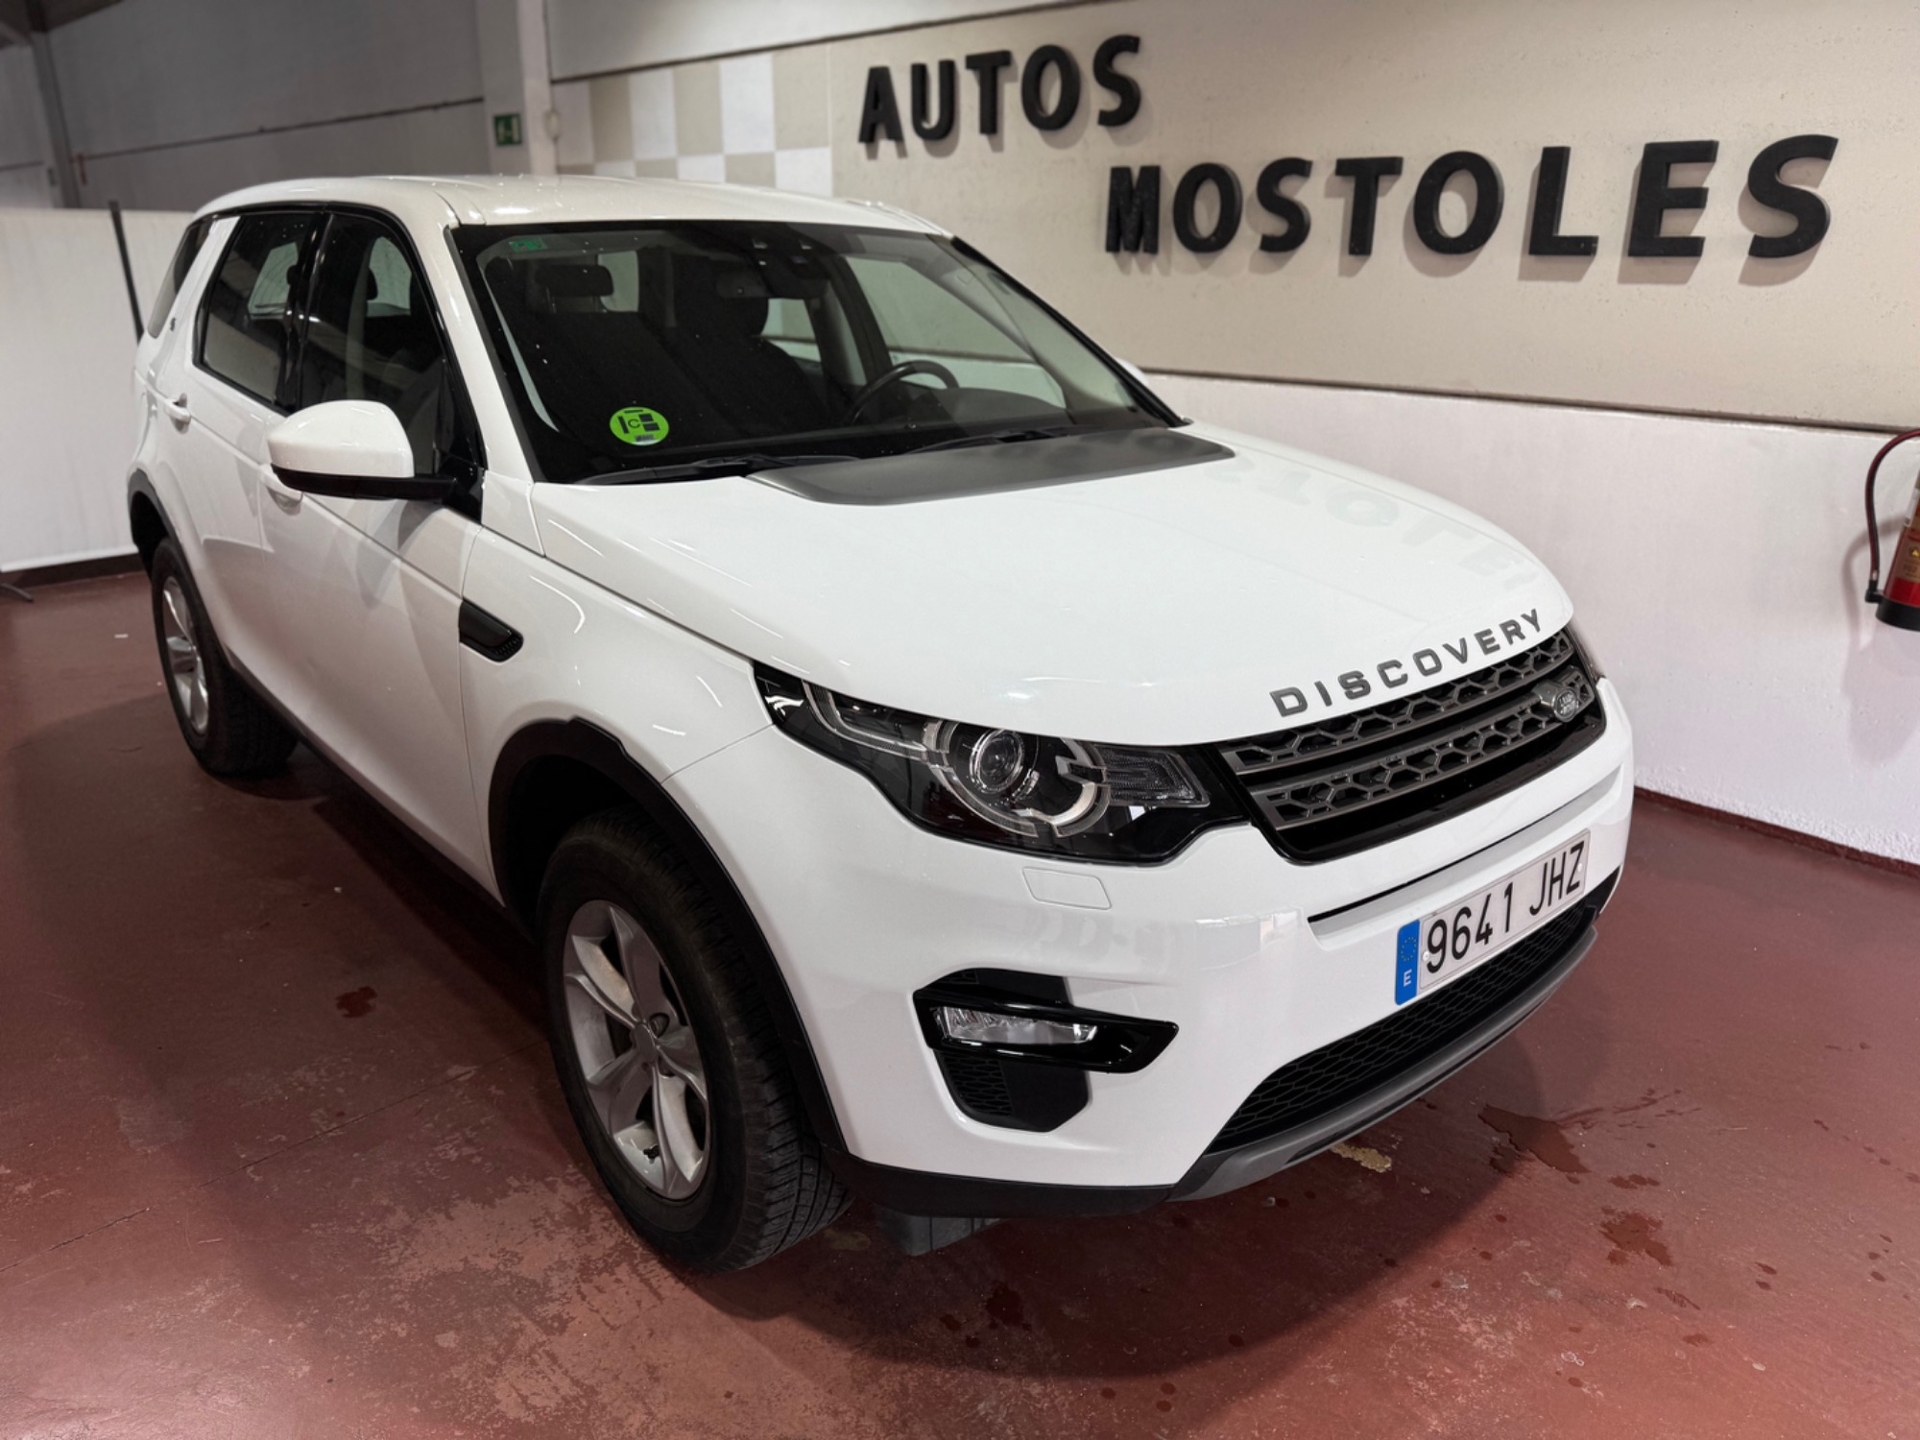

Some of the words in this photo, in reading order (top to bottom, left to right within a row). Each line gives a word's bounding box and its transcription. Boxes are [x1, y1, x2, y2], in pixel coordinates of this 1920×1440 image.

[858, 34, 1141, 144] AUTOS
[1105, 135, 1839, 258] MOSTOLES
[1269, 608, 1543, 717] DISCOVERY
[1403, 968, 1413, 988] E
[1426, 882, 1513, 974] 9641
[1529, 841, 1585, 916] JHZ
